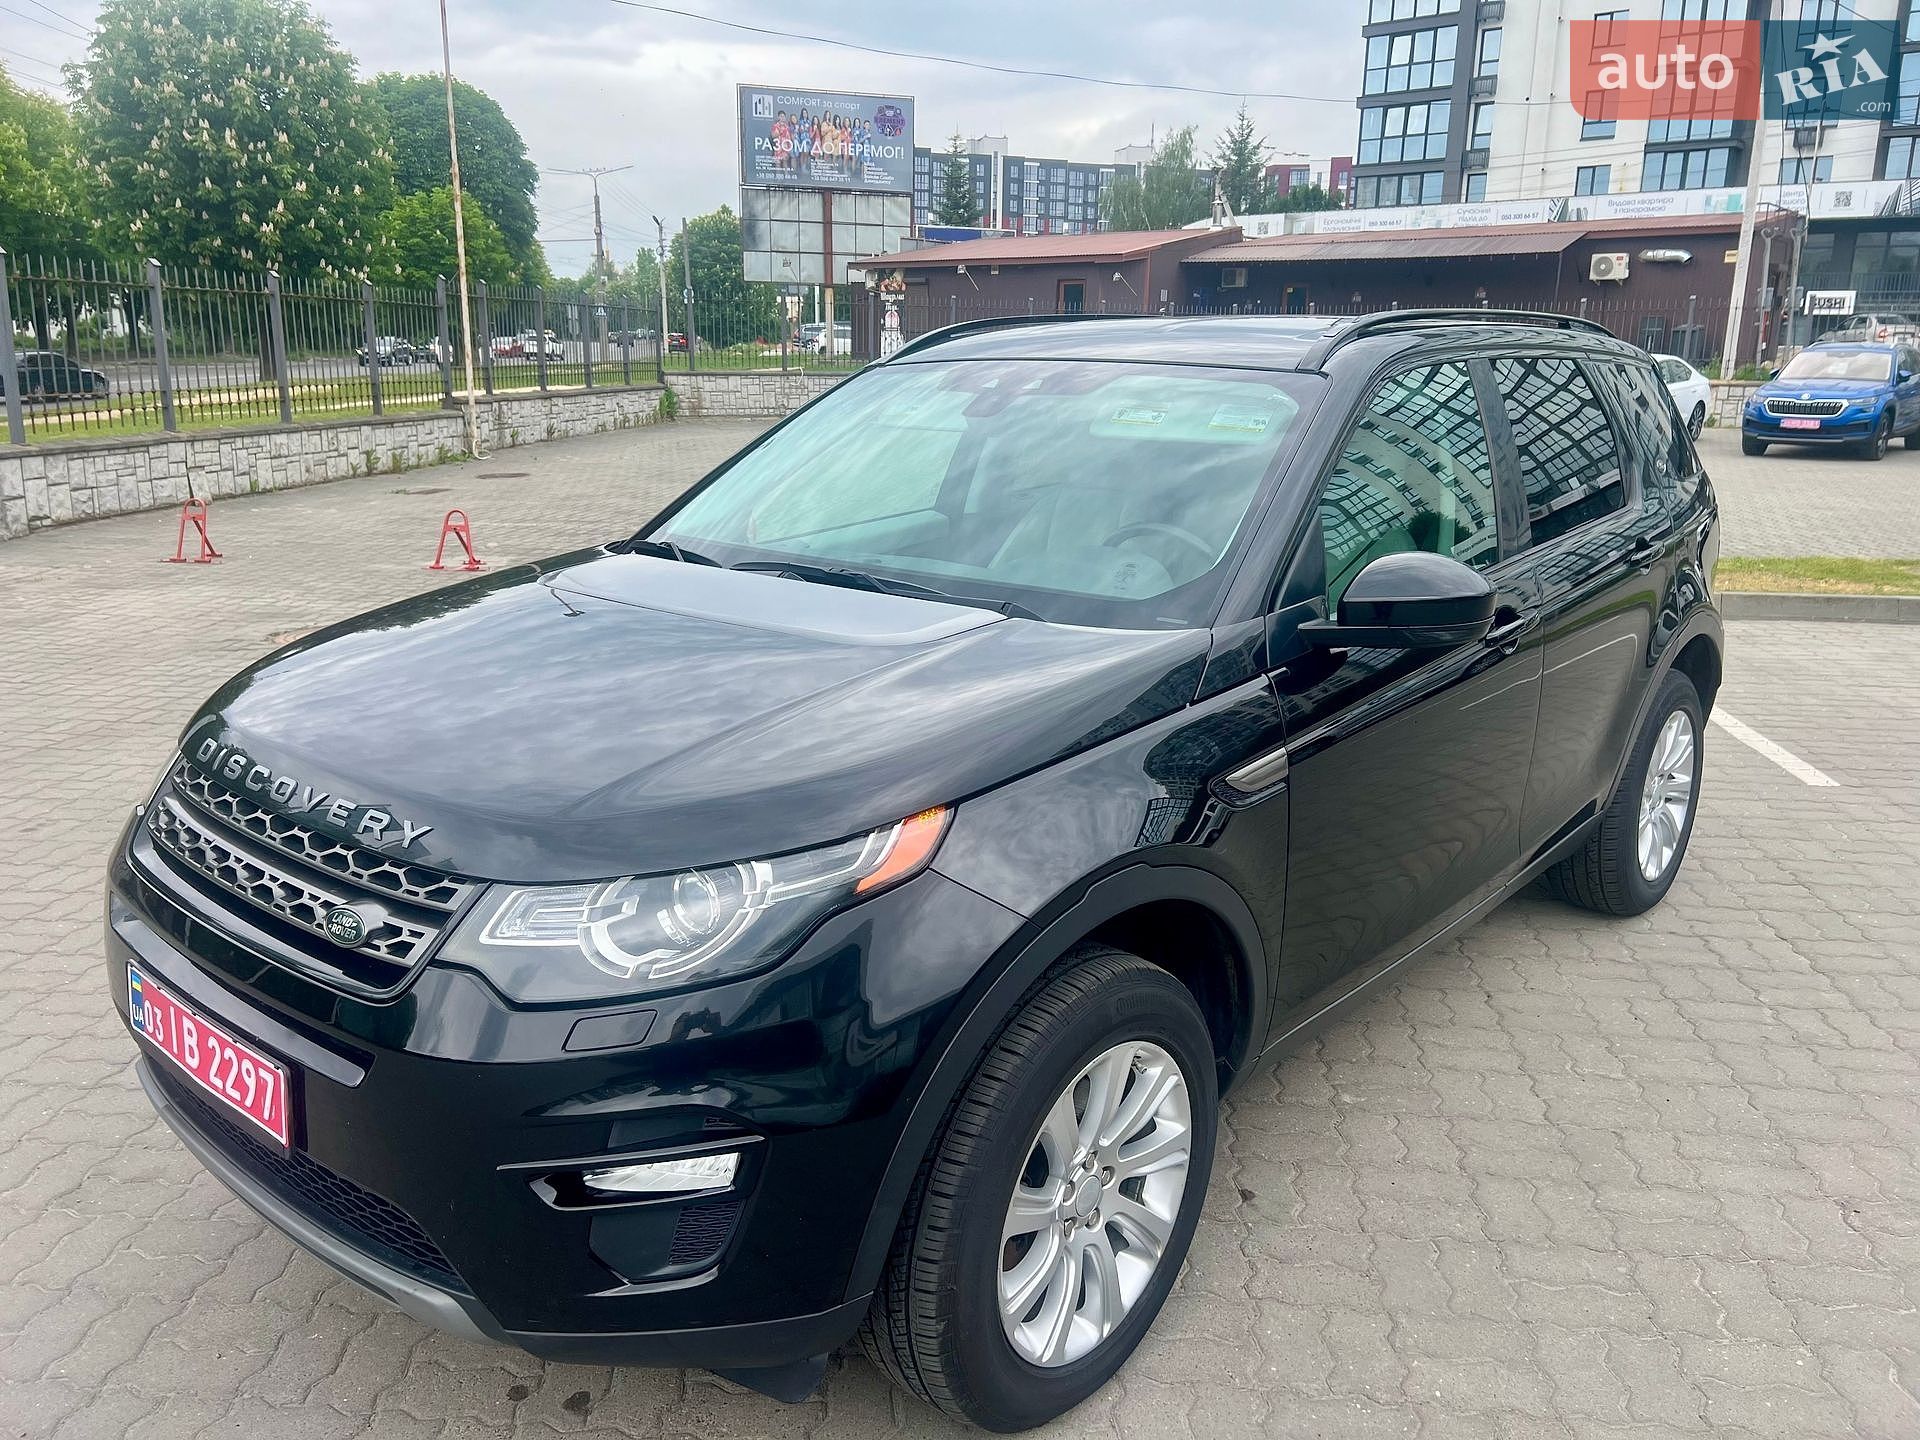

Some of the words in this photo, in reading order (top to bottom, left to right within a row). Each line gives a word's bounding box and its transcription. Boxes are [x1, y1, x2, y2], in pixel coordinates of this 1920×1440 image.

[777, 96, 820, 107] COMFORT
[834, 102, 860, 110] спорт
[754, 137, 807, 153] РАЗОМ
[811, 143, 835, 156] ДО
[1619, 206, 1667, 214] панорамою
[1637, 197, 1674, 206] квартира
[196, 737, 434, 849] DISCOVERY
[332, 912, 354, 928] LAND
[331, 923, 357, 940] ROVER
[133, 1004, 145, 1025] UA
[143, 999, 165, 1044] 03
[207, 1035, 275, 1122] 2297
